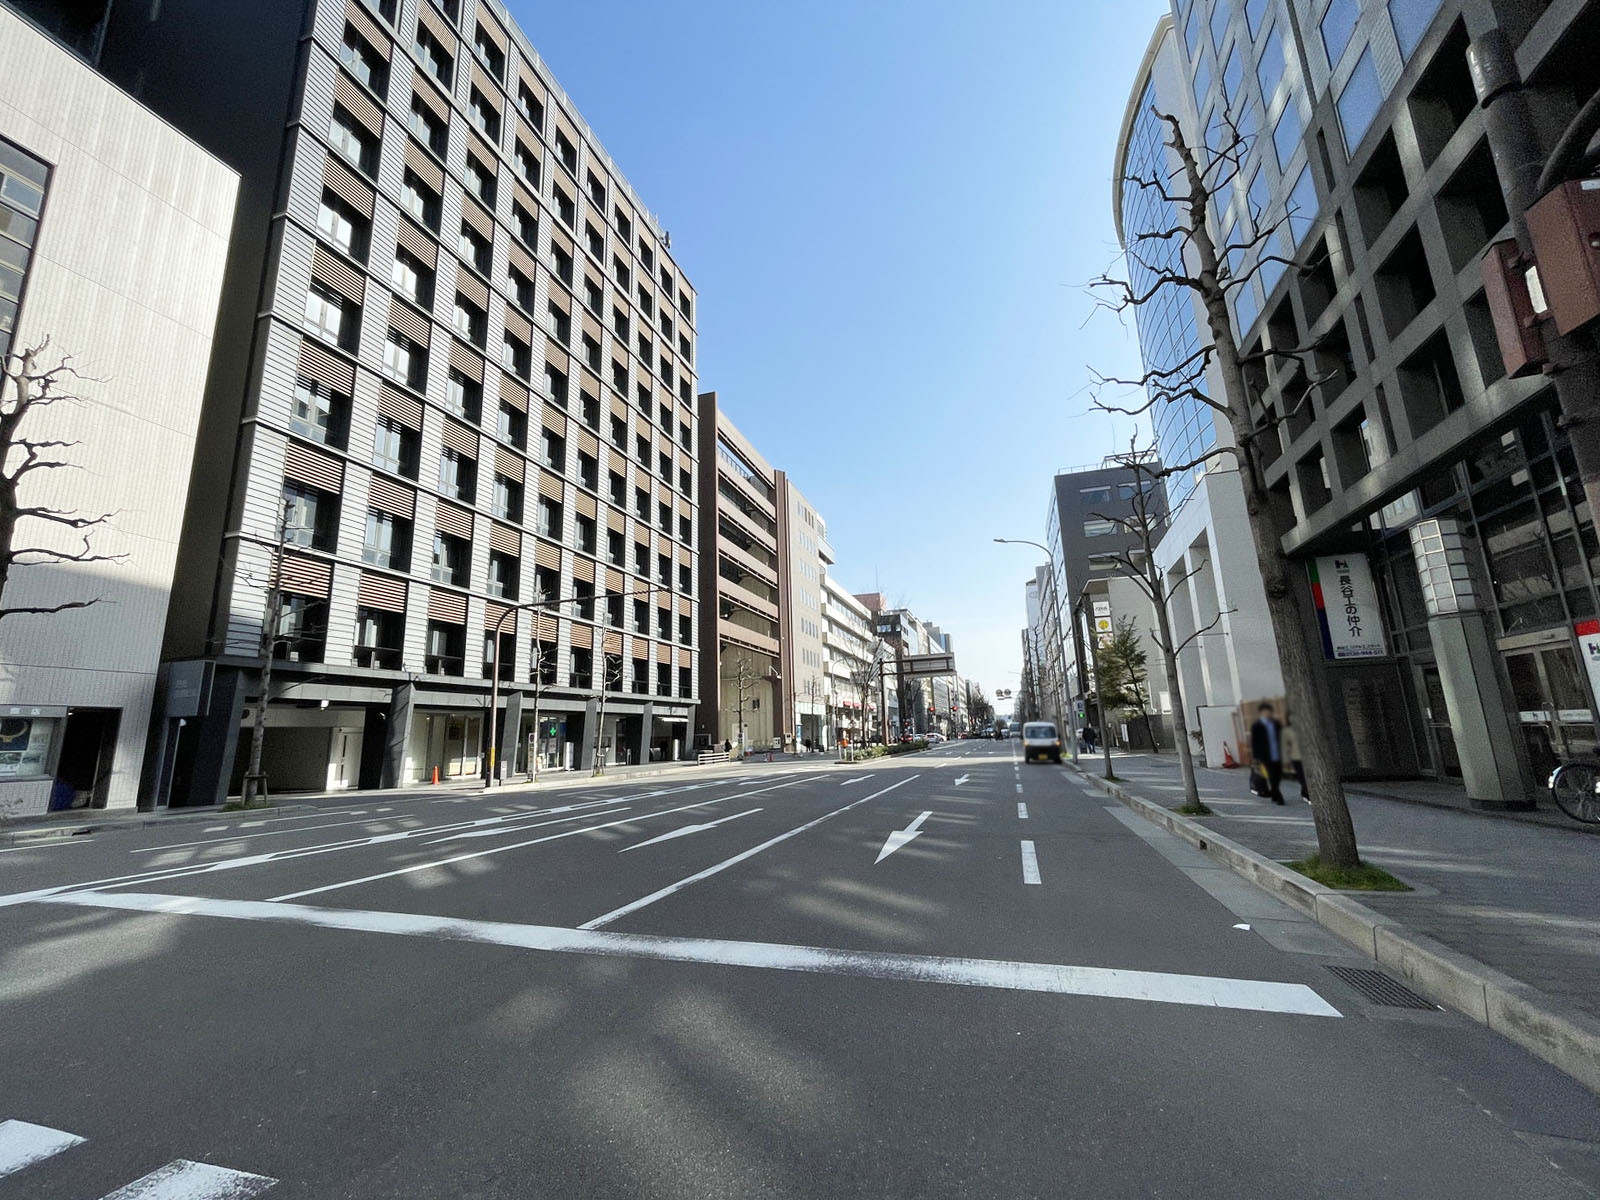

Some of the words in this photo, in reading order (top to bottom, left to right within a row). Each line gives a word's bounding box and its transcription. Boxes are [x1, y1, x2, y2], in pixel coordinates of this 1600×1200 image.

[1340, 575, 1362, 637] 長谷工の仲介
